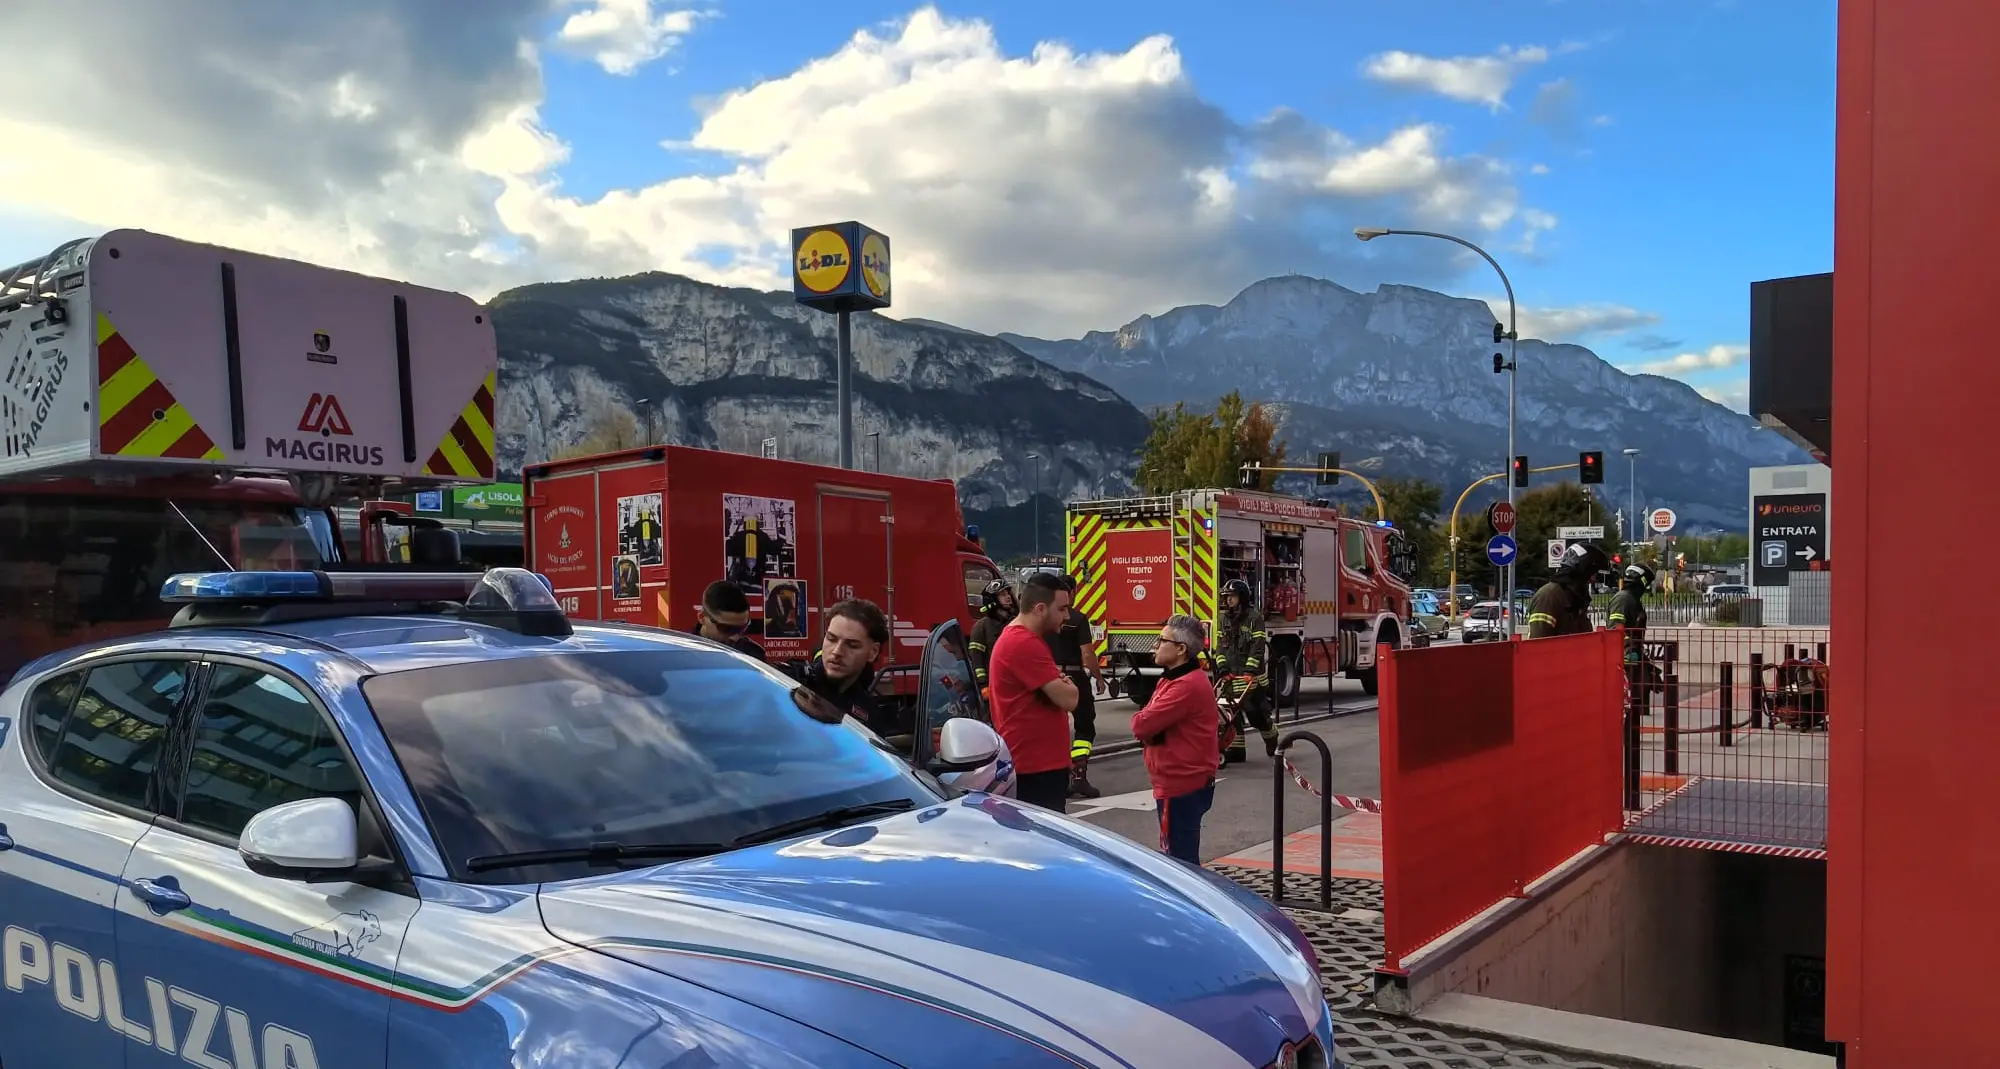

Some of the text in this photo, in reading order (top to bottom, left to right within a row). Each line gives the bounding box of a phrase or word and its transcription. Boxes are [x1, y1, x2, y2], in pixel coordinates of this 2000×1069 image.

[21, 350, 68, 458] MAGIRUS
[265, 437, 384, 466] MAGIRUS
[1239, 499, 1320, 518] VIGILI DEL FUOCO TRENTO
[1773, 504, 1822, 514] unieuro
[1494, 511, 1514, 524] STOP
[1762, 526, 1817, 537] ENTRATA
[1111, 555, 1168, 565] VIGILI DEL FUOCO
[1767, 547, 1783, 565] P
[1126, 566, 1153, 574] TRENTO
[835, 585, 853, 599] 115
[561, 597, 579, 615] 115
[763, 640, 800, 648] LABORATORIO
[3, 924, 320, 1069] POLIZIA
